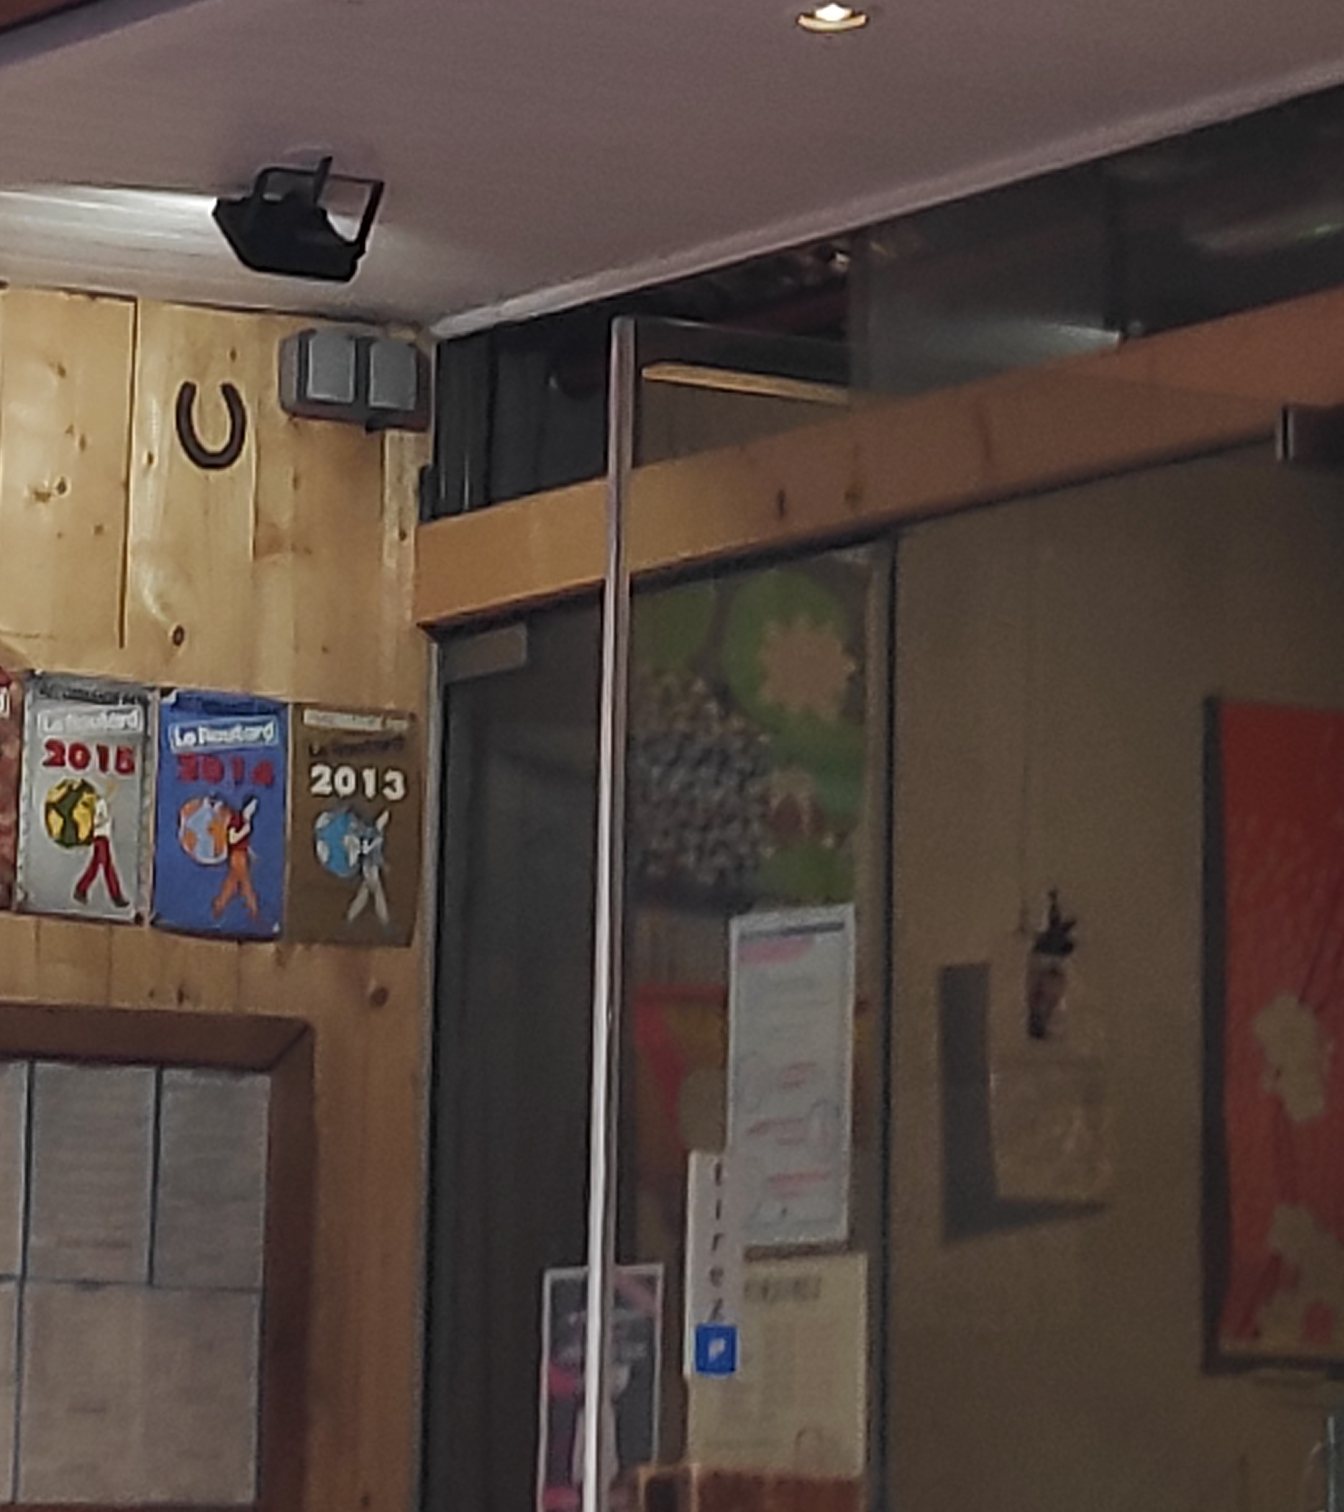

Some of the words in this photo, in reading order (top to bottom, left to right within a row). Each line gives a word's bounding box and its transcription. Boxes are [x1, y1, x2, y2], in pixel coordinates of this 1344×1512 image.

[198, 719, 276, 746] Routard
[41, 739, 136, 776] 2015
[309, 763, 407, 802] 2013
